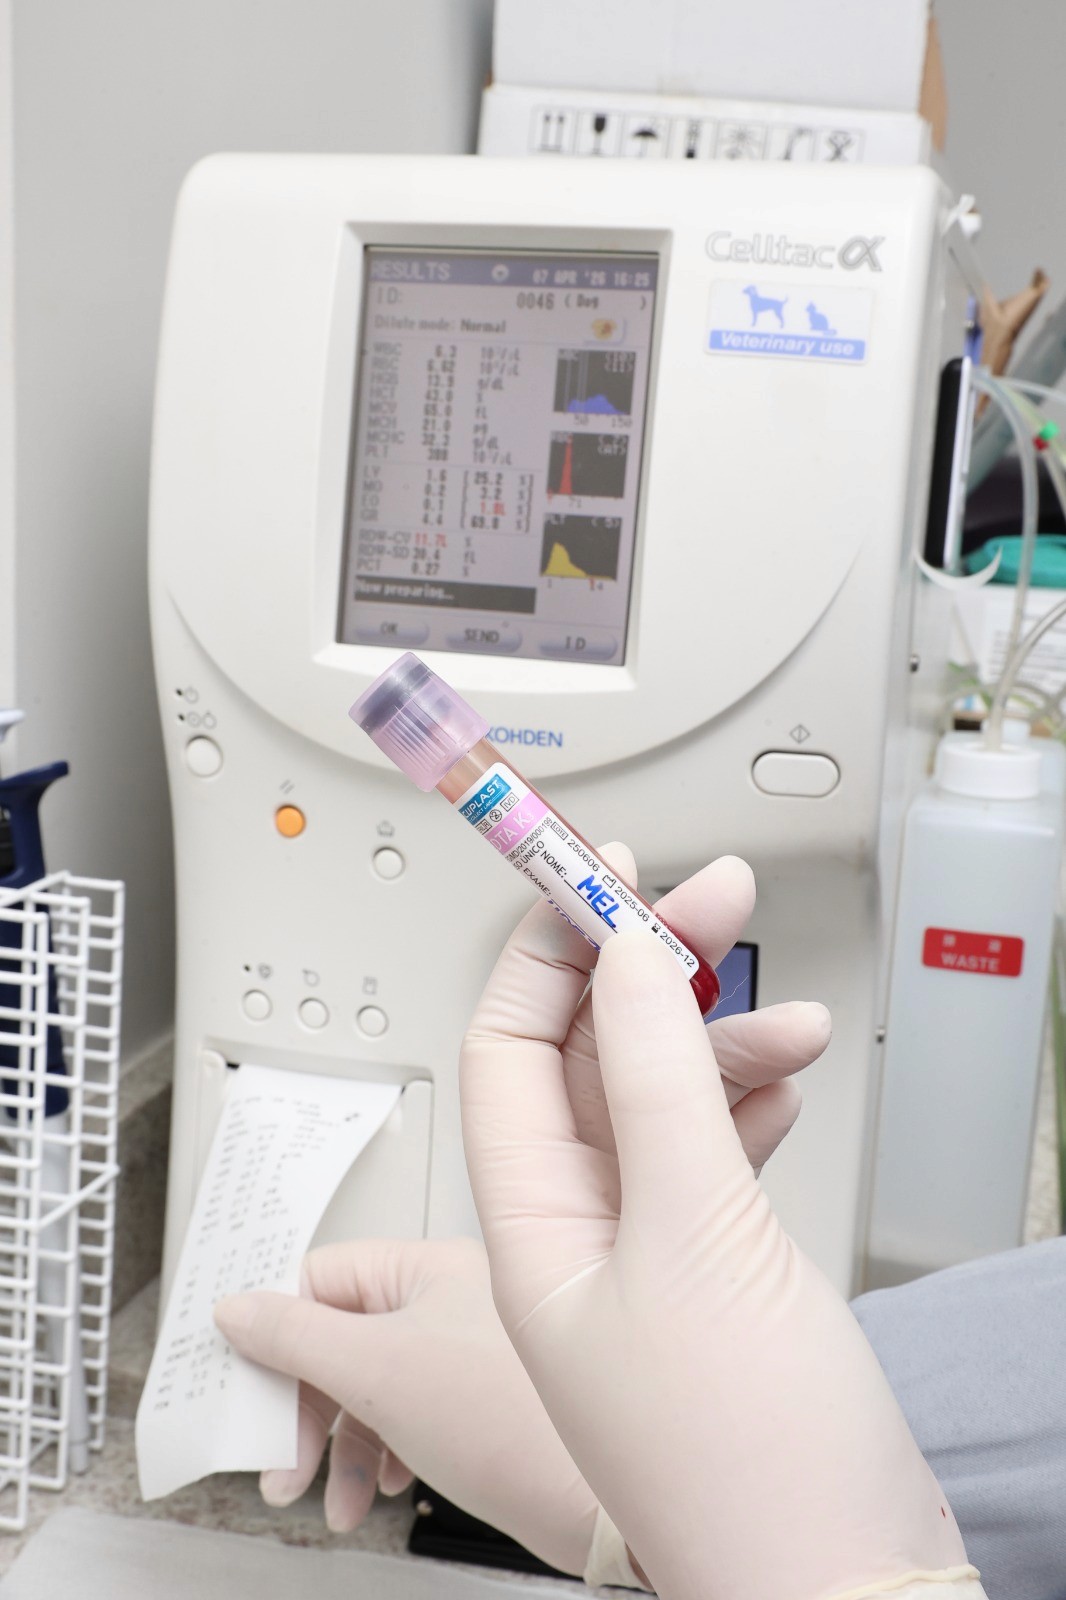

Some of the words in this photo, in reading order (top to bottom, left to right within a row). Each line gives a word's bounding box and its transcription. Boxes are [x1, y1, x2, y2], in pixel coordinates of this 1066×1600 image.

[371, 260, 451, 280] RESULTS
[516, 292, 555, 310] 0046
[460, 319, 507, 333] Normal
[720, 332, 816, 356] Veterinary
[819, 342, 855, 356] use
[380, 621, 398, 635] OK
[464, 629, 500, 644] SEND
[521, 841, 544, 863] ÚNICO
[540, 850, 567, 878] NOME:
[523, 867, 551, 896] EXAME:
[567, 839, 600, 872] 250606
[614, 886, 649, 922] 2025-06
[660, 931, 695, 968] 2026-12
[577, 874, 619, 928] MEL
[941, 951, 999, 972] WASTE
